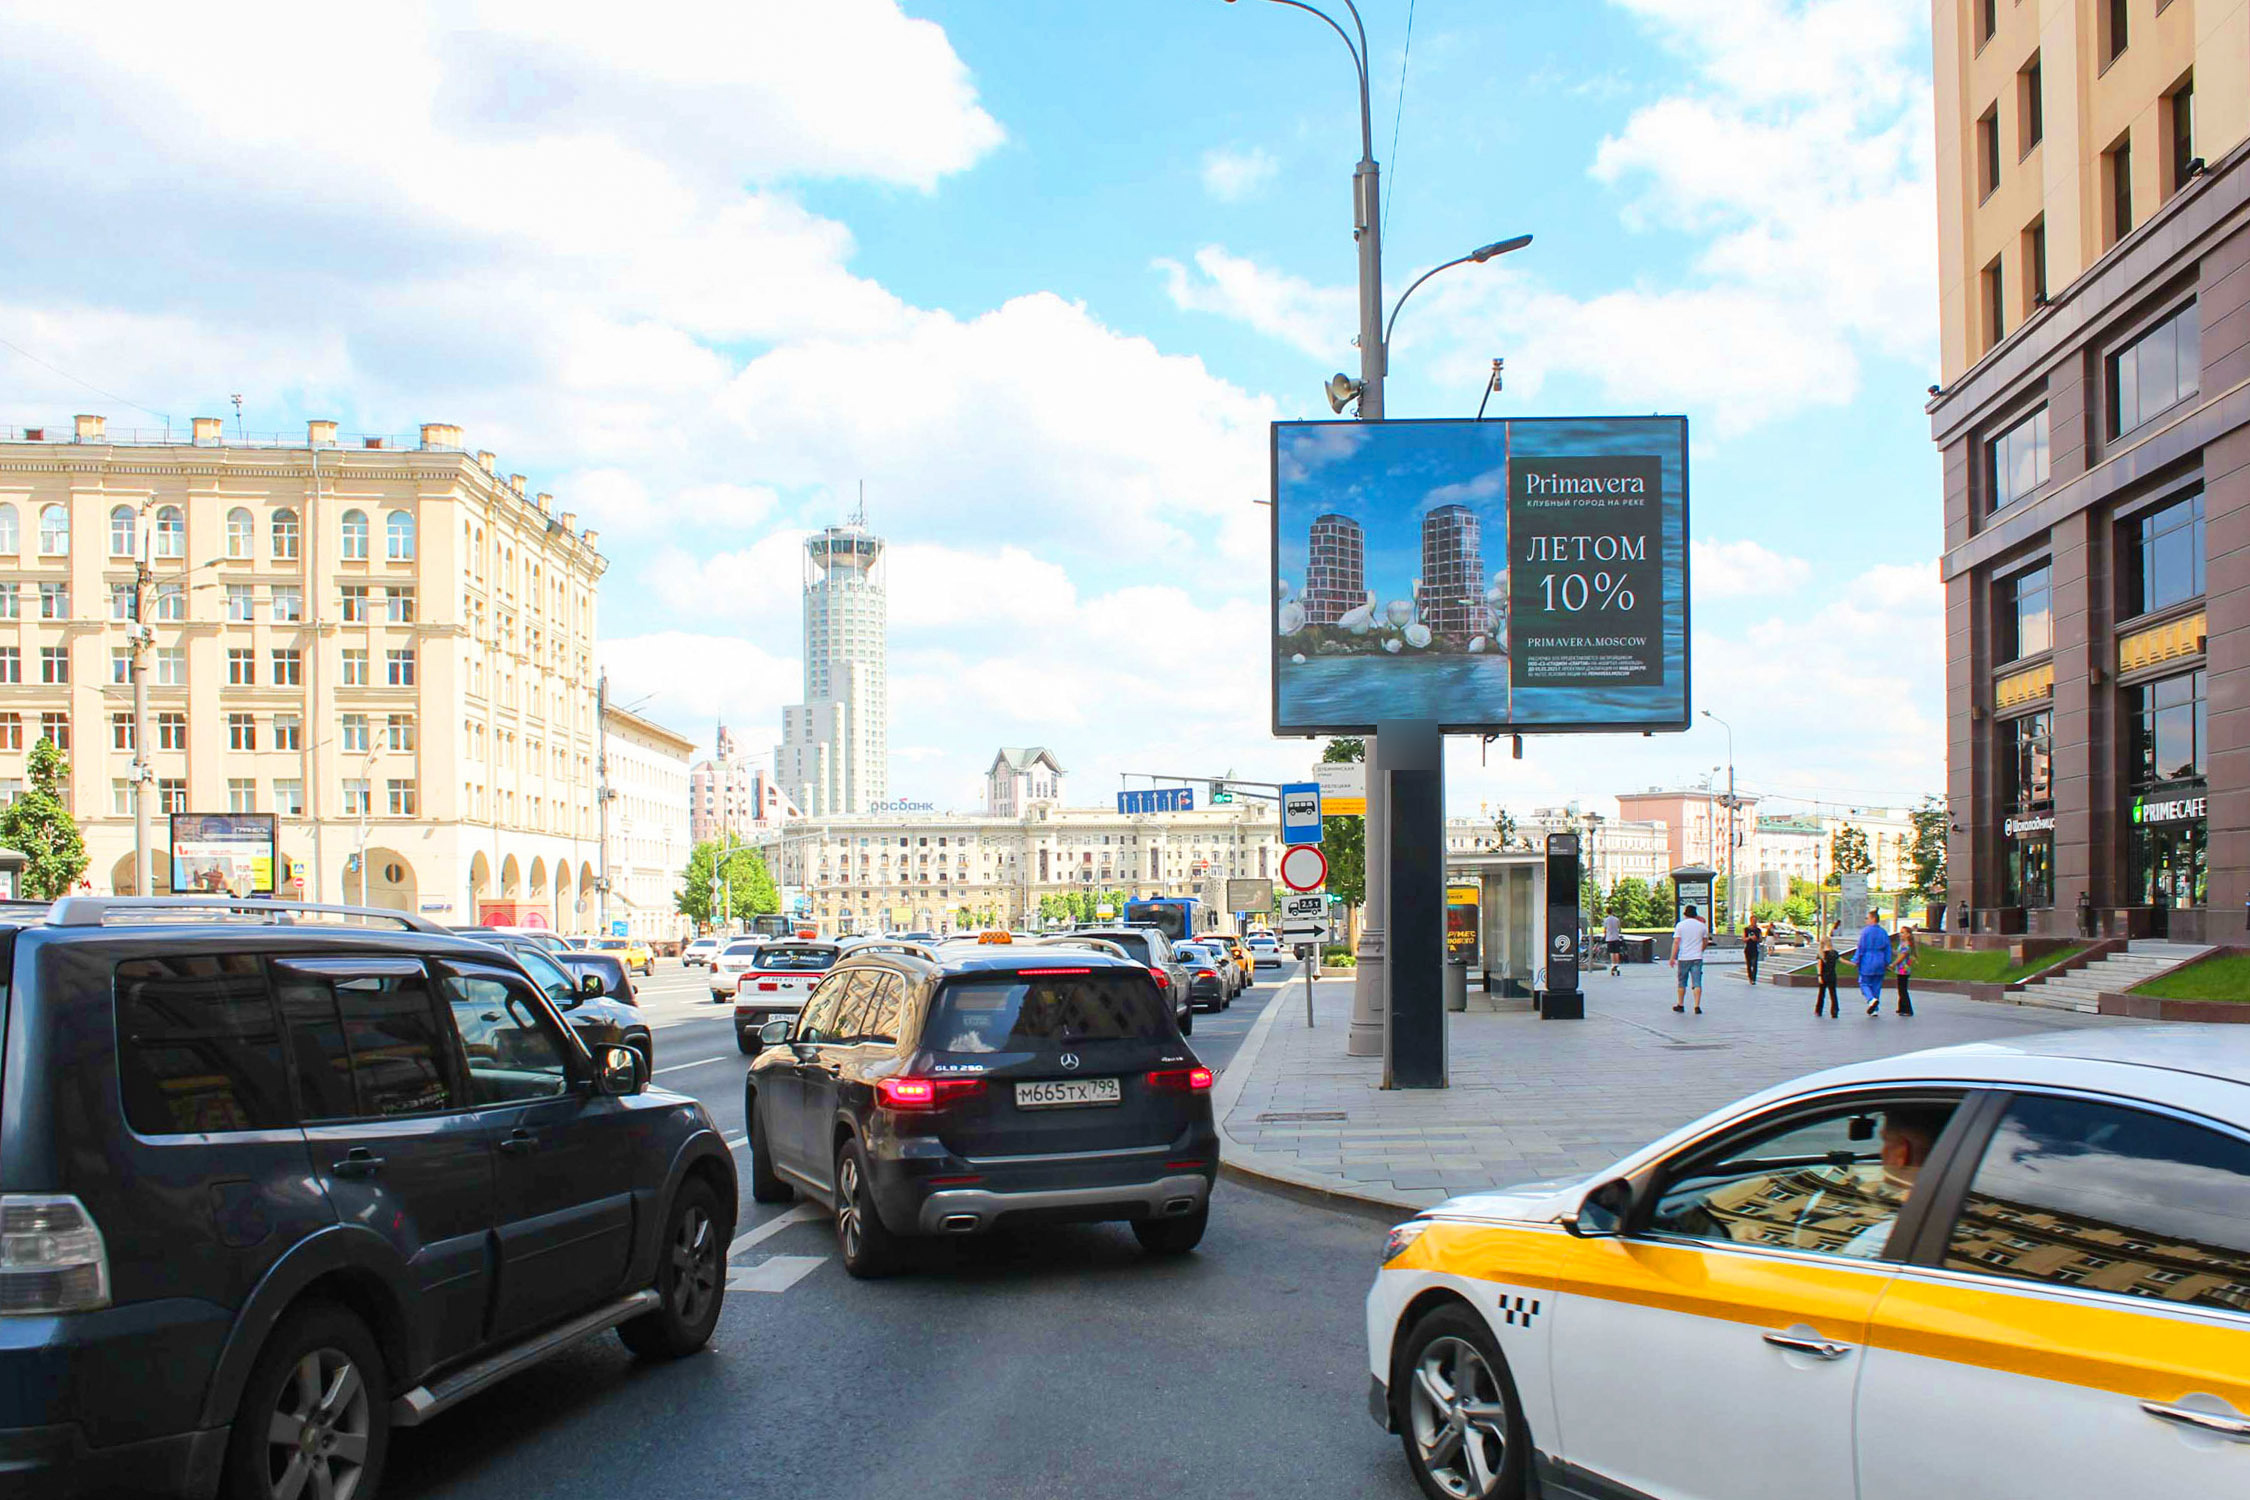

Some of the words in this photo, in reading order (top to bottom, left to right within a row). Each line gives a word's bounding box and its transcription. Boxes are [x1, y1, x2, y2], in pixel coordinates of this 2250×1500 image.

[1526, 473, 1645, 494] Primavera
[1527, 499, 1571, 507] КЛУБНЫЙ
[1573, 499, 1604, 507] ГОРОД
[1622, 498, 1645, 506] РЕКЕ
[1526, 535, 1646, 561] ЛЕТОМ
[1539, 571, 1635, 611] 10%
[1527, 637, 1647, 647] PRIMAVERA.MOSCOW
[871, 798, 933, 813] росбанк
[2143, 797, 2207, 822] PRIMECAFE
